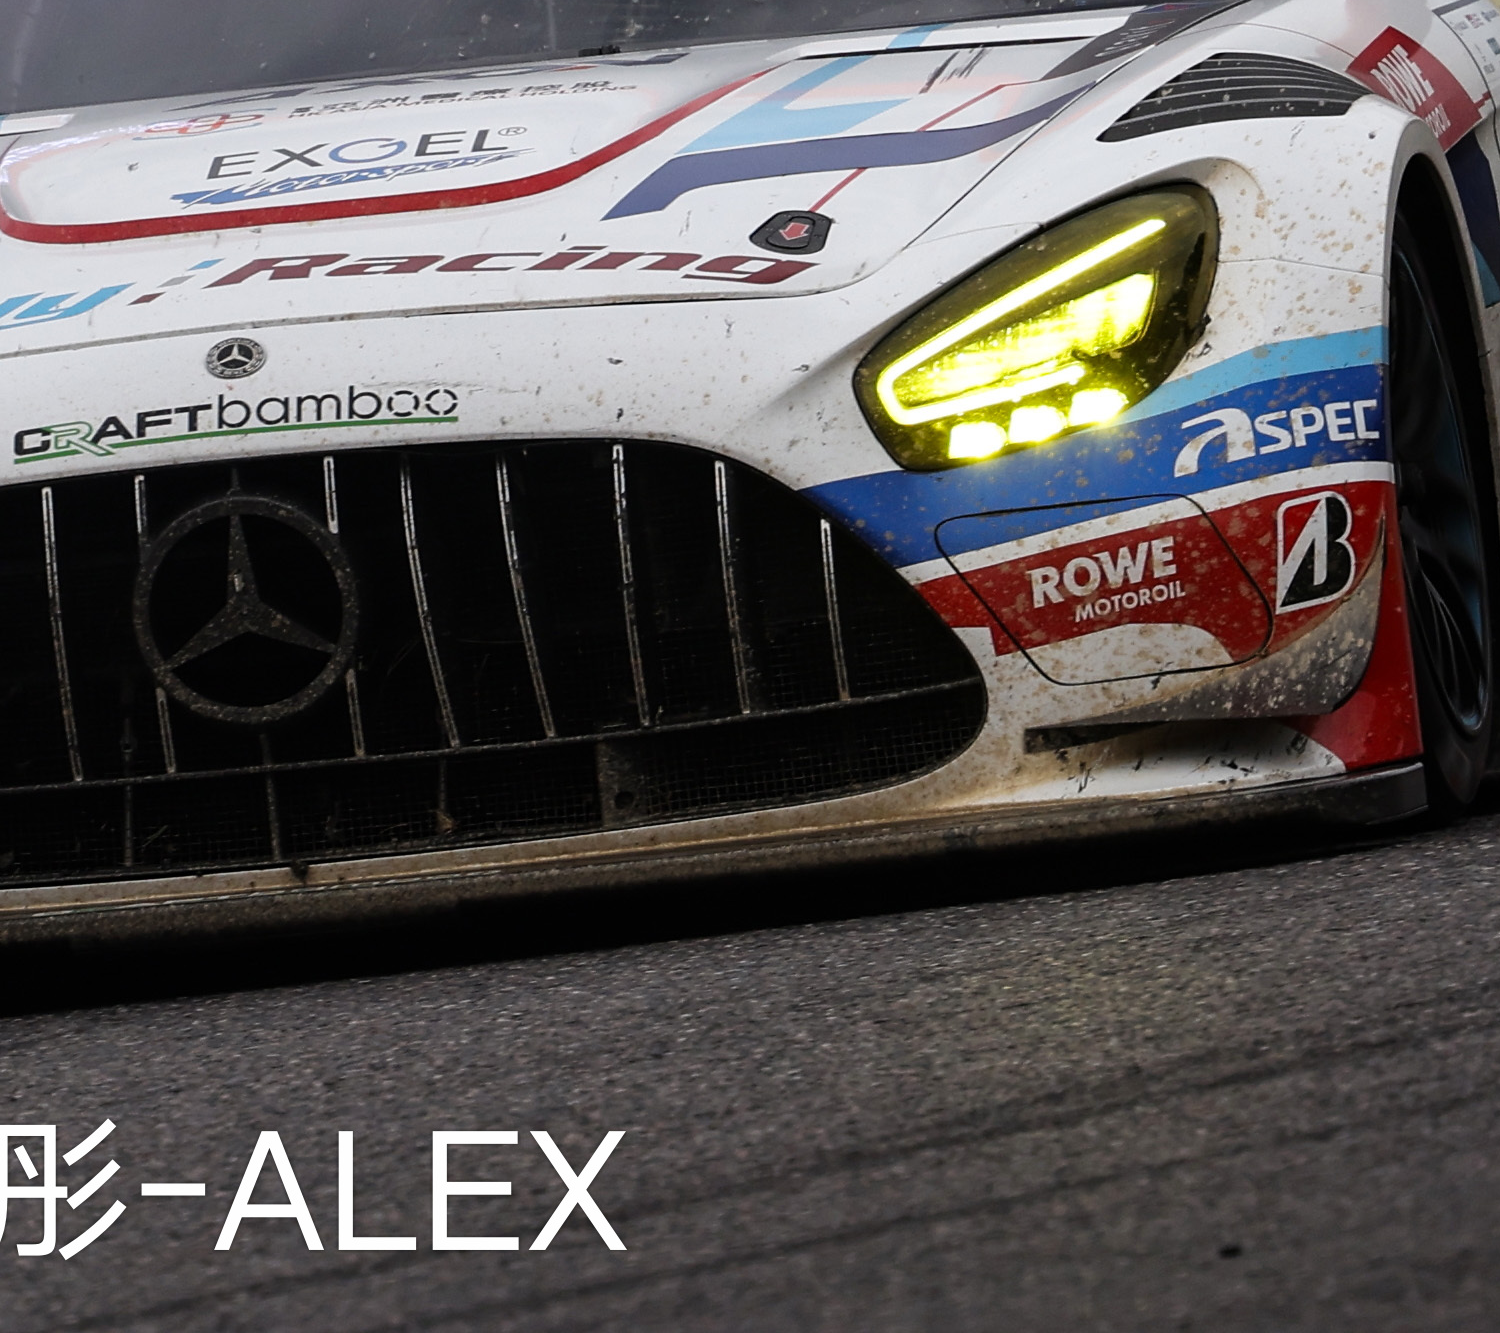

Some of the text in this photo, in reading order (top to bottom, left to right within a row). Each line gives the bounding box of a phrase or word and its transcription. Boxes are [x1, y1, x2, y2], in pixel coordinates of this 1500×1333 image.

[204, 244, 834, 287] Racing
[13, 383, 459, 459] CRAFTbamboo
[1027, 535, 1178, 609] ROWE
[1074, 580, 1186, 623] MOTOROIL
